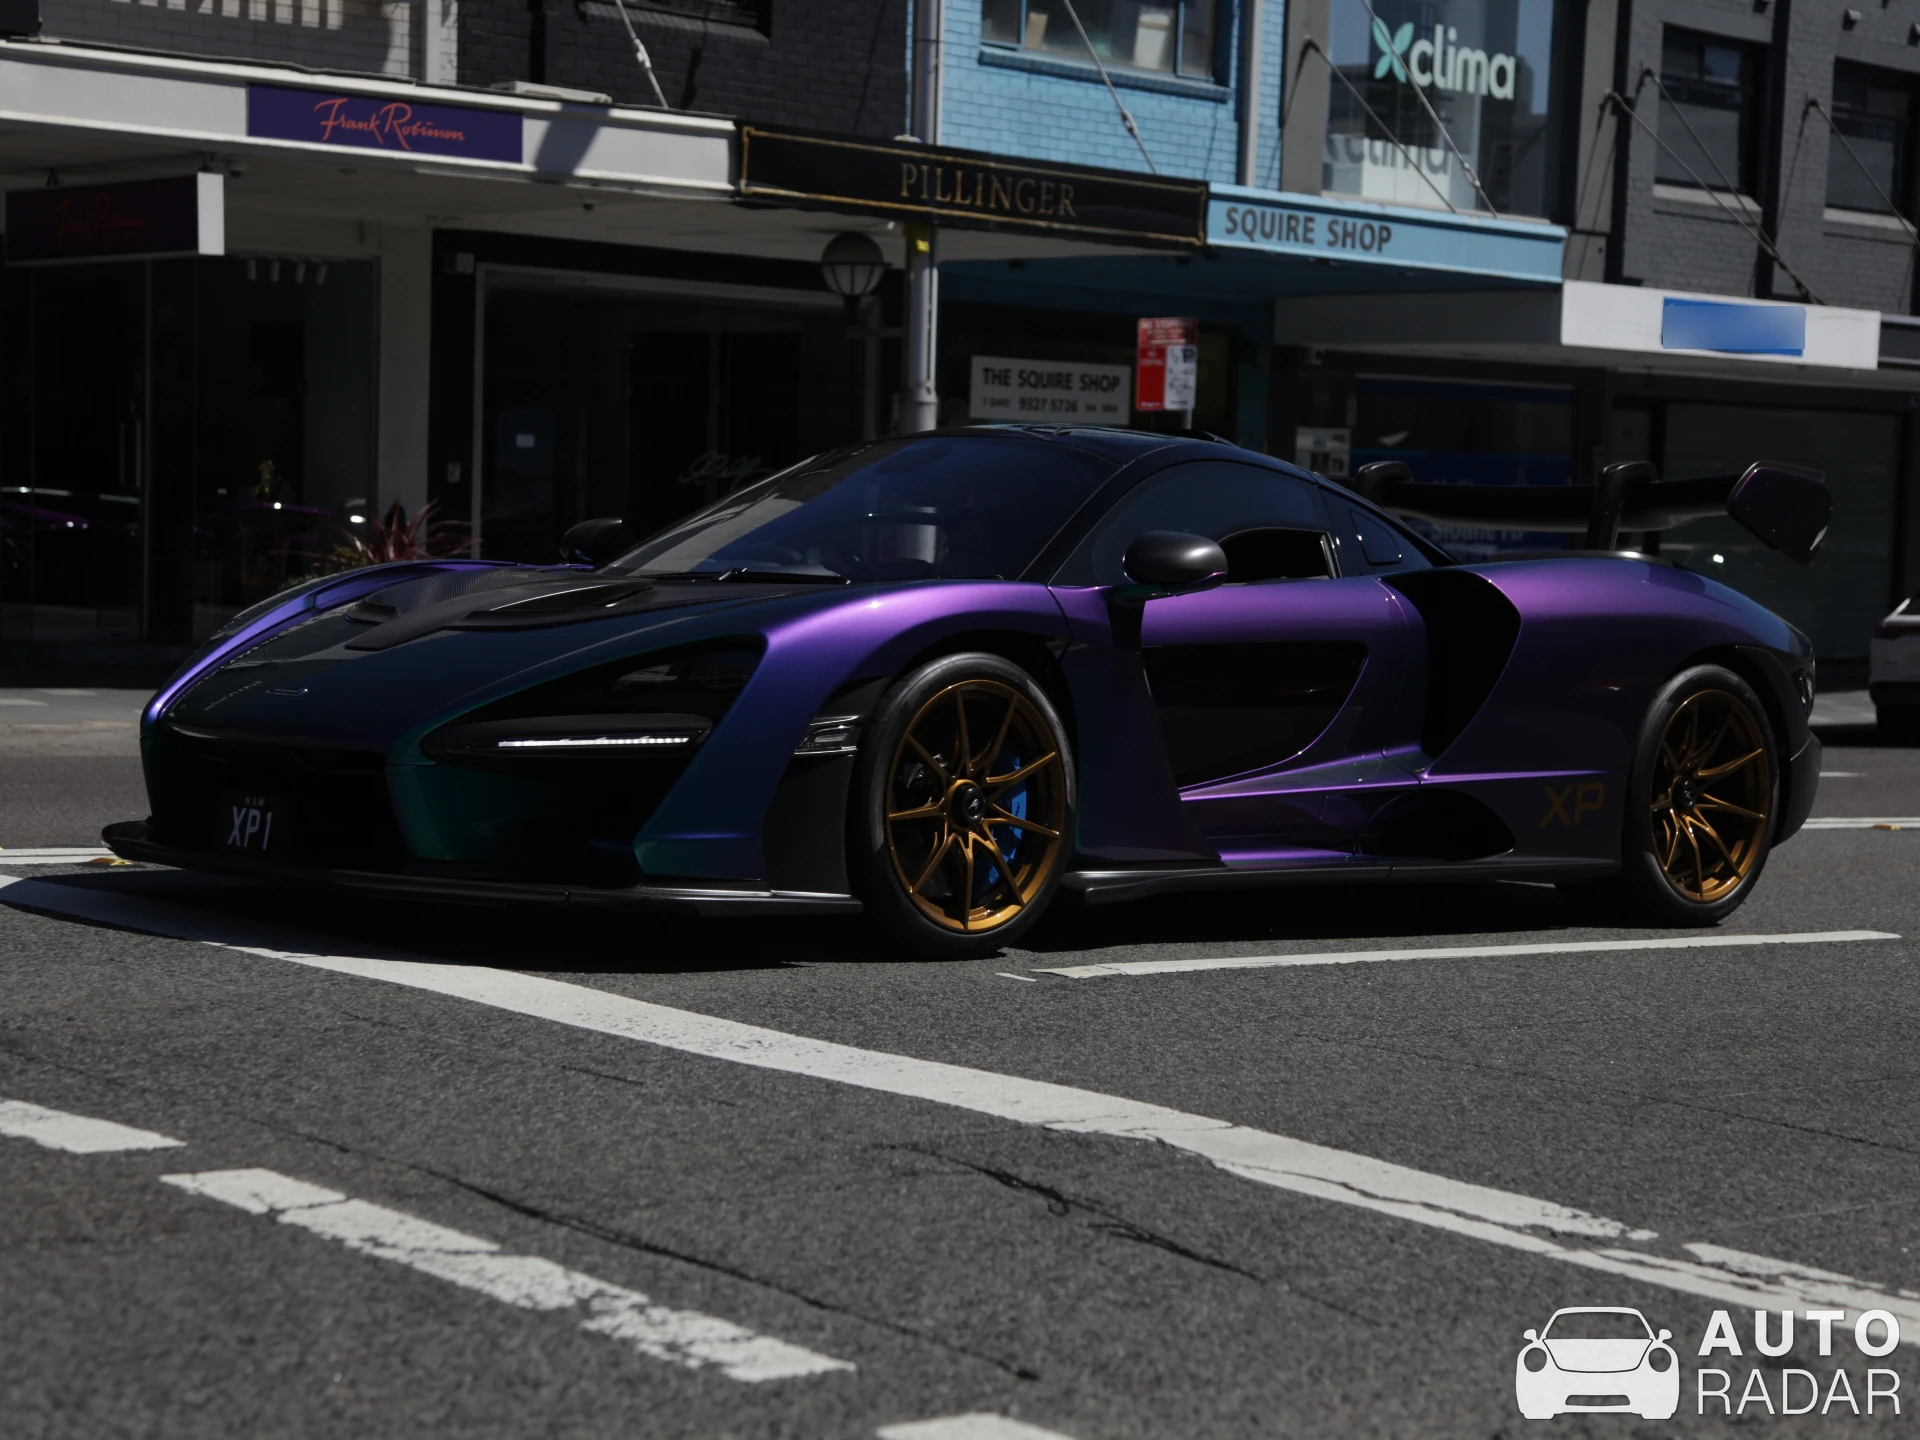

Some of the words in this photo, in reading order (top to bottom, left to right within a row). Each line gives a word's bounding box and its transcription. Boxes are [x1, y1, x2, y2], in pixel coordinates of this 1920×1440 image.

[1409, 23, 1516, 100] clima
[314, 97, 384, 144] Frank
[900, 162, 1077, 217] PILLINGER
[1225, 207, 1316, 244] SQUIRE
[1327, 218, 1392, 252] SHOP
[982, 367, 1011, 387] THE
[1017, 370, 1073, 390] SQUIRE
[1079, 373, 1121, 393] SHOP
[244, 796, 265, 807] NSW
[1539, 782, 1604, 828] XP
[227, 806, 273, 850] XP1
